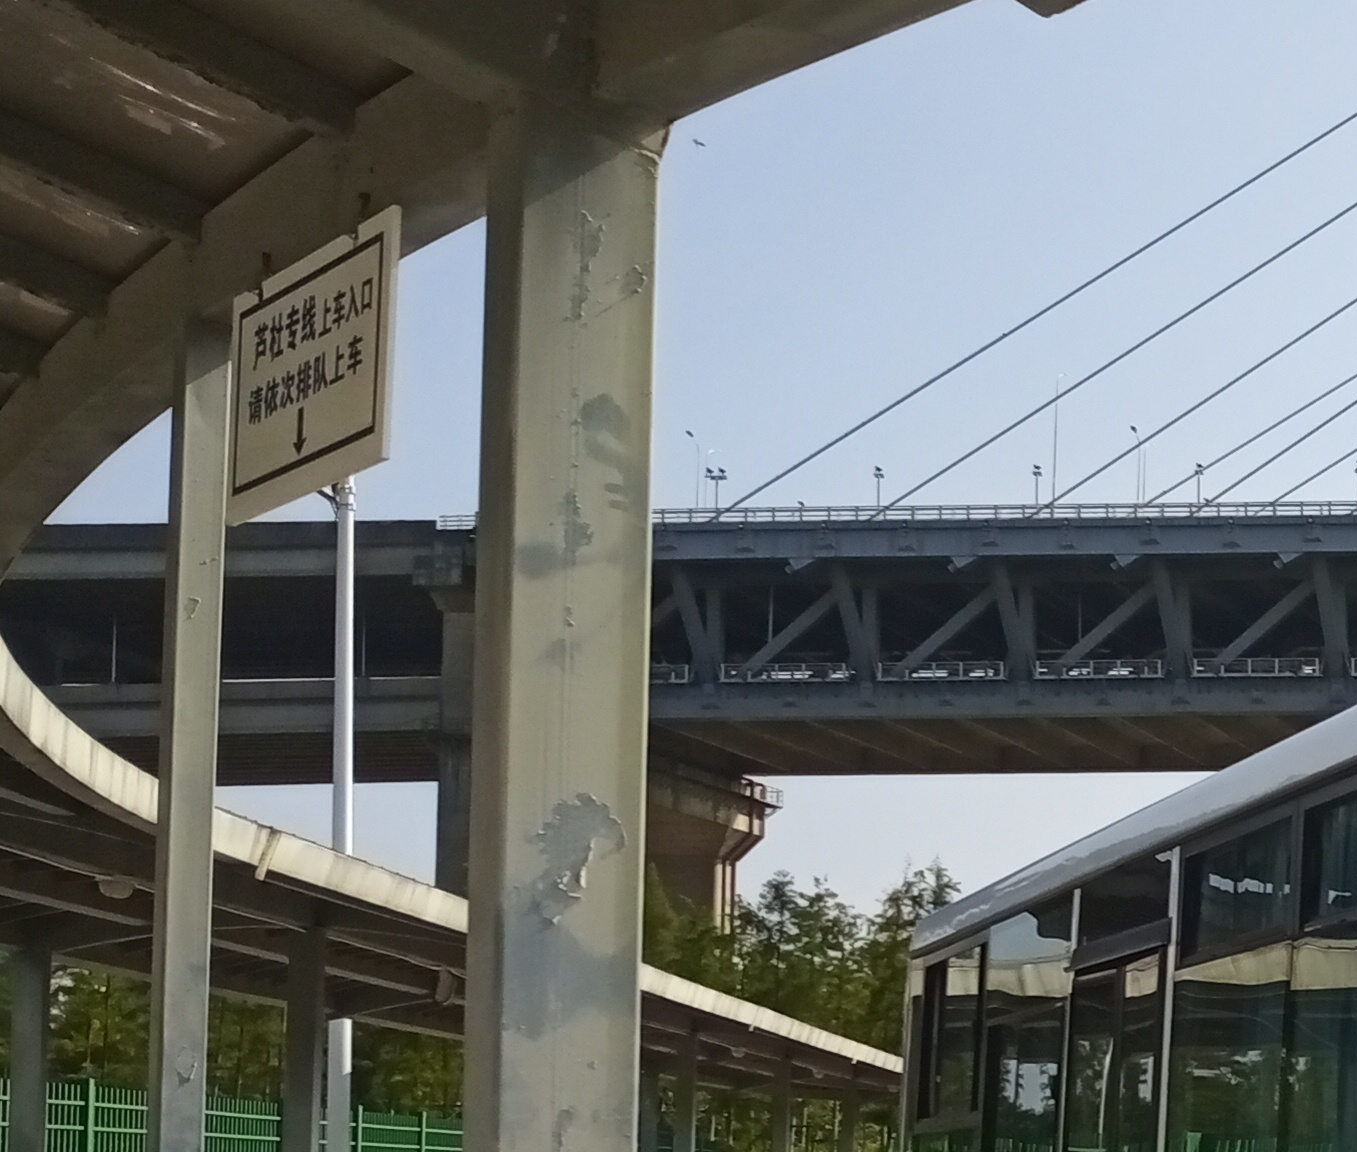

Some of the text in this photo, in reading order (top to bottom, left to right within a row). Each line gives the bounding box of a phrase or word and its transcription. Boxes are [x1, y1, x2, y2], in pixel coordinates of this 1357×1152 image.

[253, 278, 374, 371] 芦杜专线上车入口
[248, 335, 363, 425] 请依次排队上车
